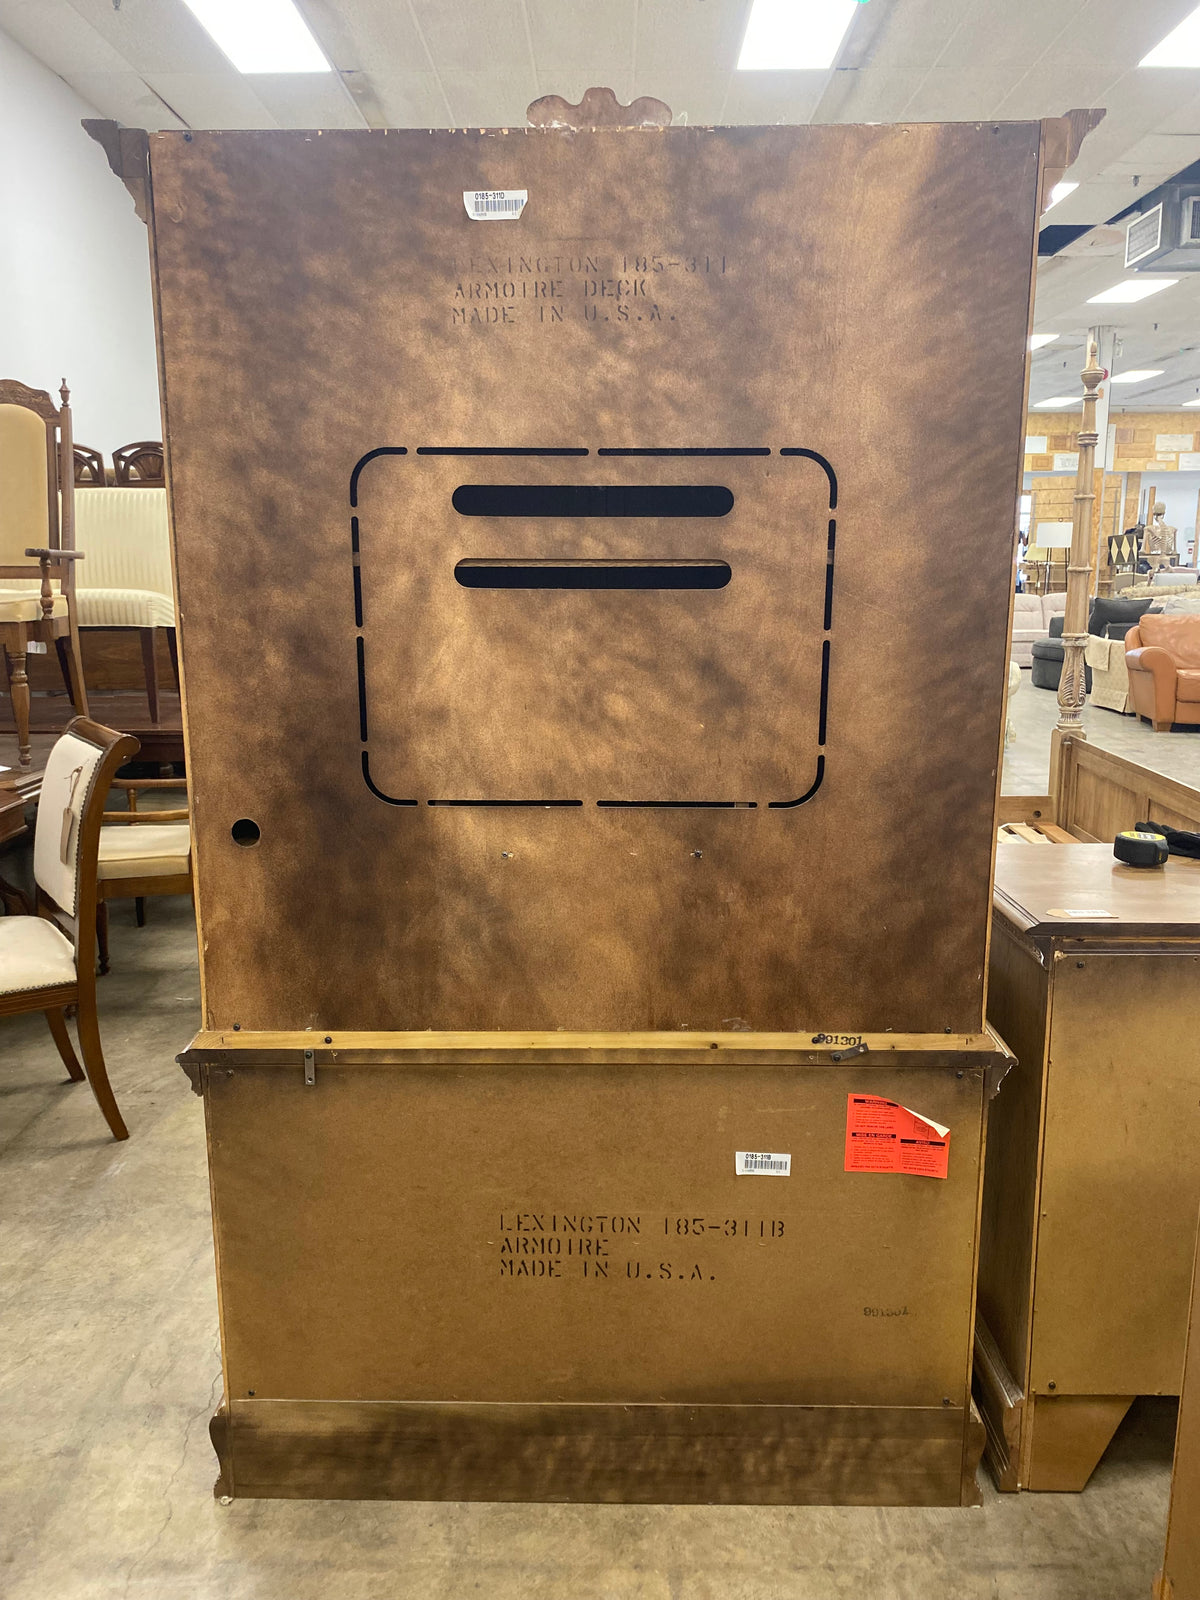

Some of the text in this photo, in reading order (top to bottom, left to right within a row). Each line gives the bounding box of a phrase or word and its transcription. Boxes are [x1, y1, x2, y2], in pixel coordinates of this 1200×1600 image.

[474, 191, 505, 200] 0185-311D
[453, 256, 598, 273] LEXINGTON
[454, 279, 647, 299] ARMOIRE DECK
[452, 304, 676, 324] MADE IN U.S.A.
[500, 1214, 785, 1238] LEXINGTON 185-311B
[500, 1237, 609, 1256] ARMOIRE
[500, 1259, 717, 1281] MADE IN U.S.A.
